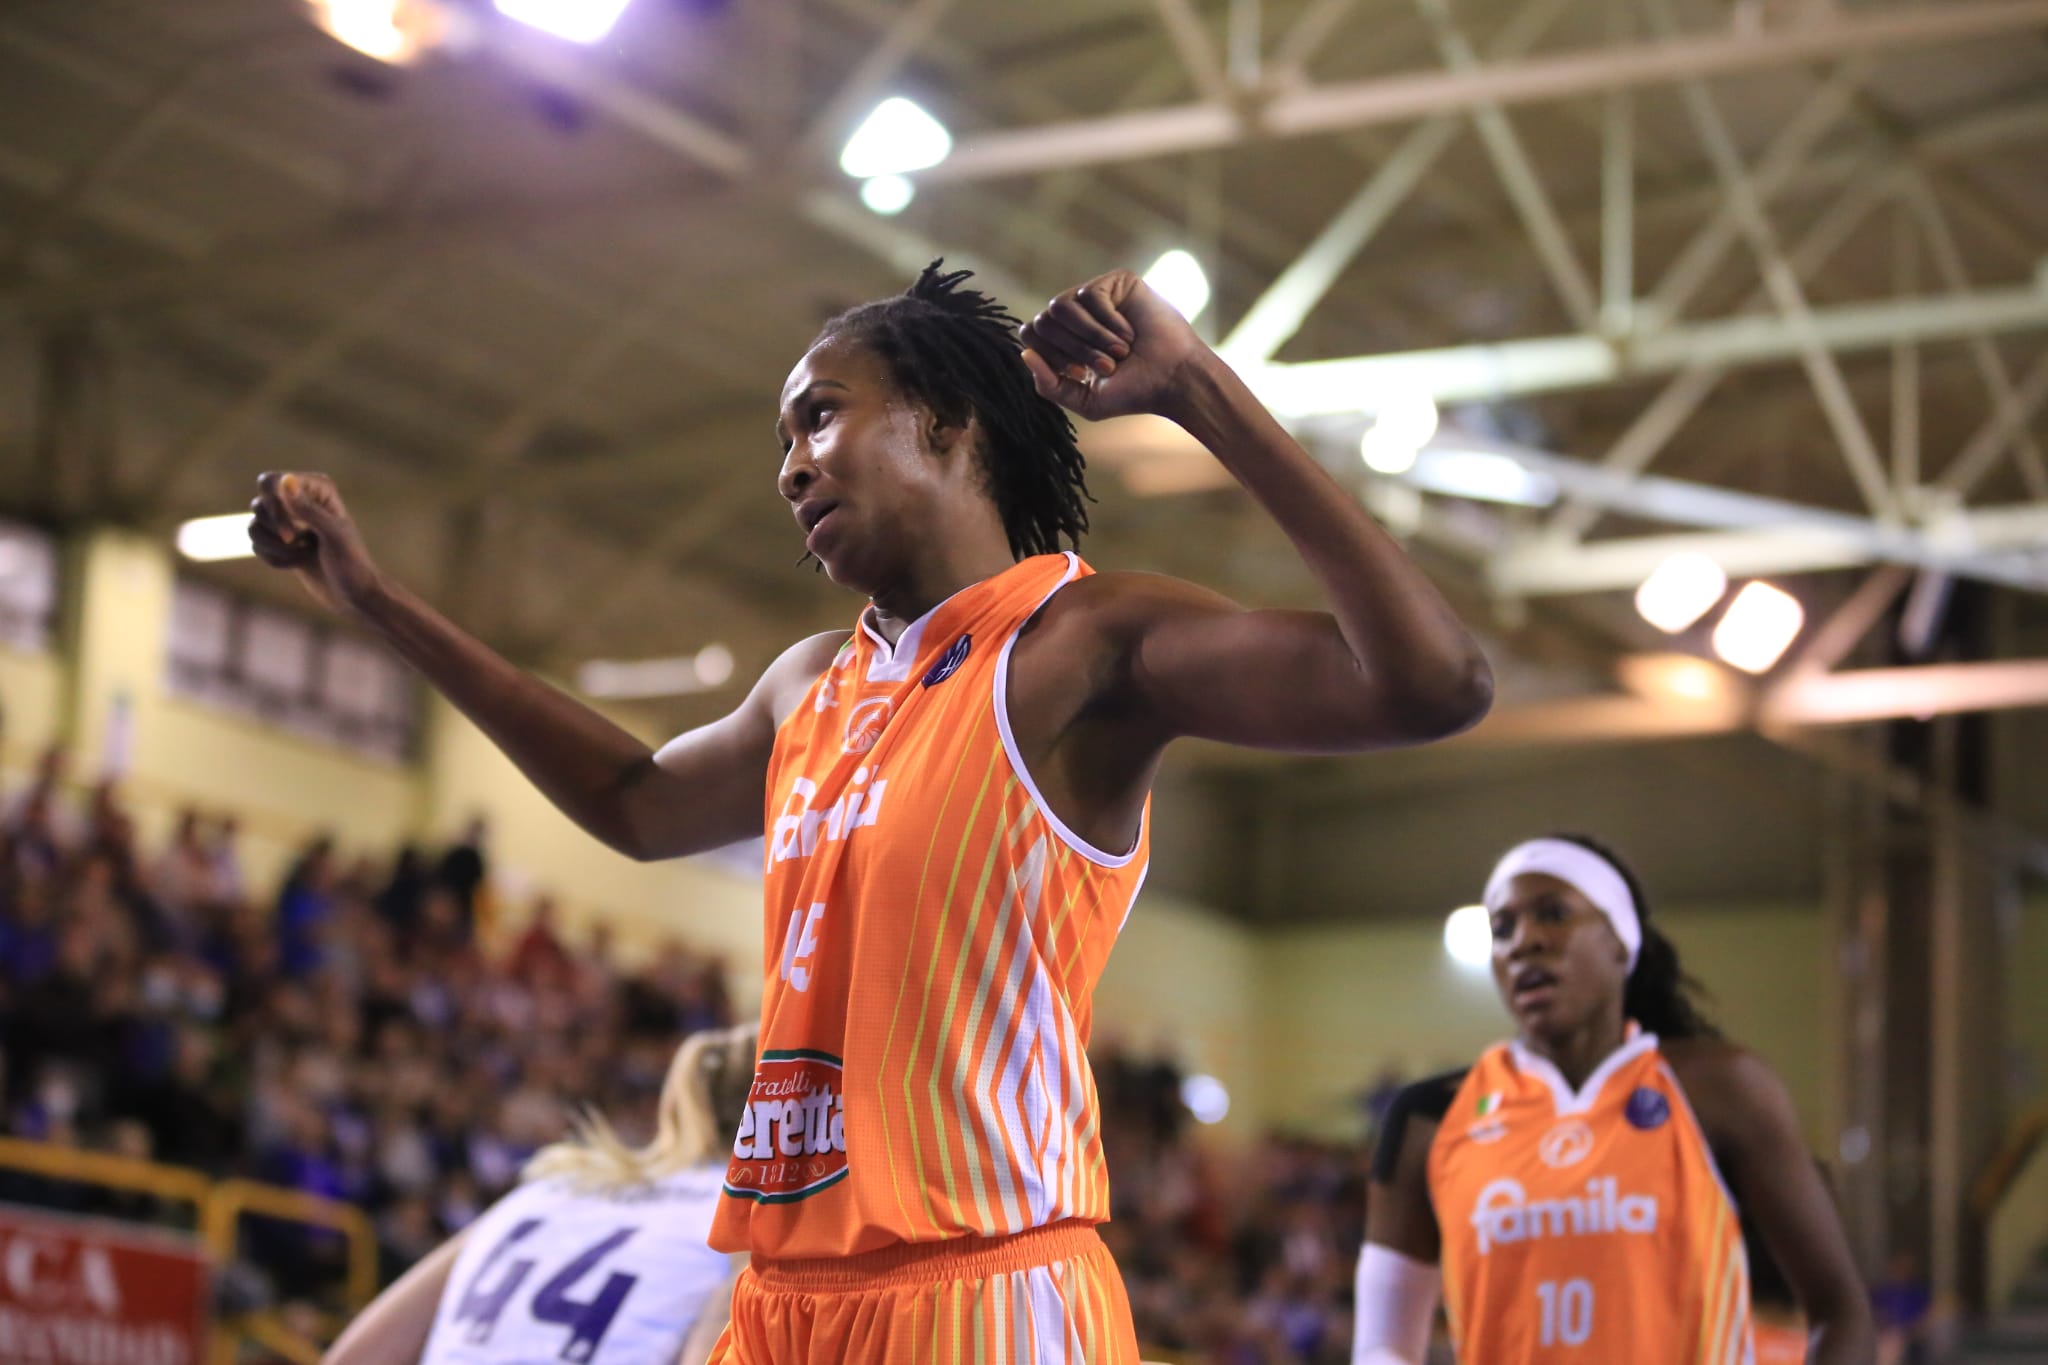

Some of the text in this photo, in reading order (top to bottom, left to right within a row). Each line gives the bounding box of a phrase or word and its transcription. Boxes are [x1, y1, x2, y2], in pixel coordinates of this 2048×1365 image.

[759, 1162, 800, 1185] 1812
[1470, 1175, 1657, 1255] famila
[453, 1217, 640, 1365] 44
[1536, 1277, 1594, 1347] 10
